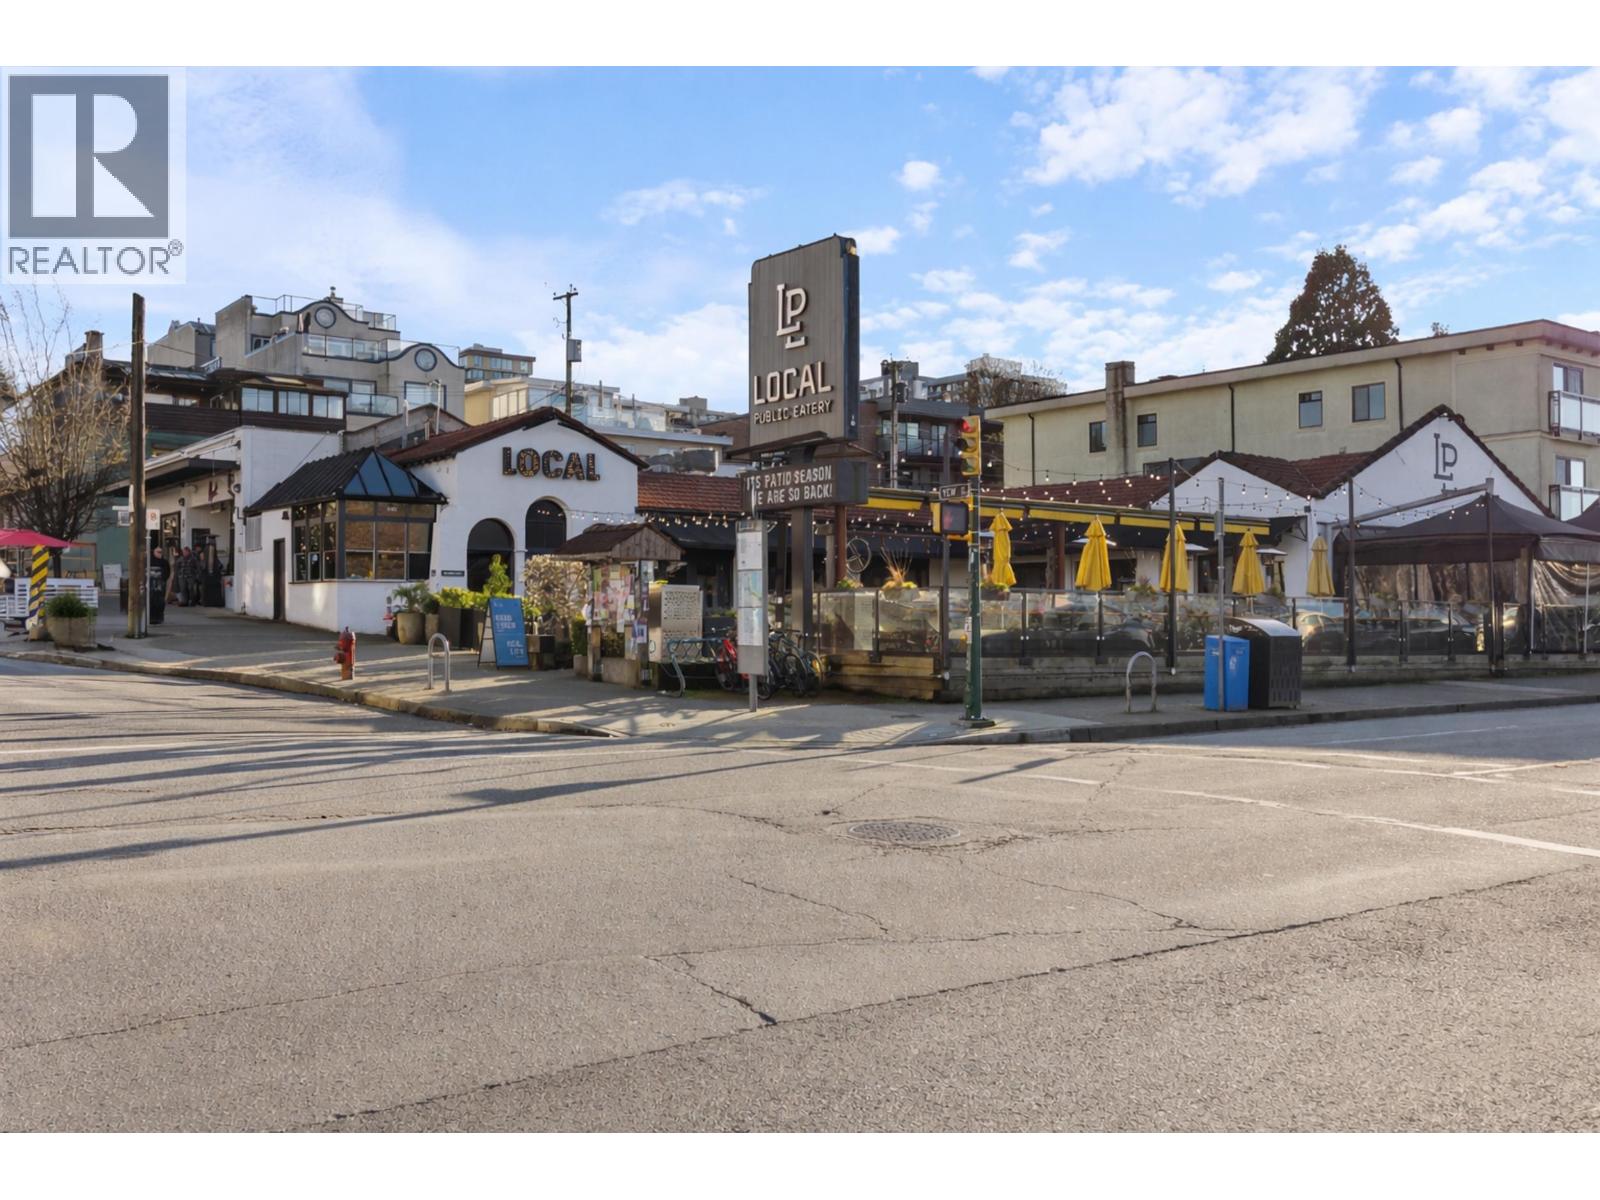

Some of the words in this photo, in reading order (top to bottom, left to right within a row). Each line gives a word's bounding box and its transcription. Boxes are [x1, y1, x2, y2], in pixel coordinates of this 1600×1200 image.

[753, 361, 832, 406] LOCAL
[753, 407, 790, 425] PUBLIC
[793, 399, 832, 418] EATERY
[502, 446, 601, 481] LOCAL
[794, 464, 832, 485] SEASON
[767, 488, 786, 505] ARE
[788, 487, 801, 502] SO
[804, 483, 834, 501] BACK!
